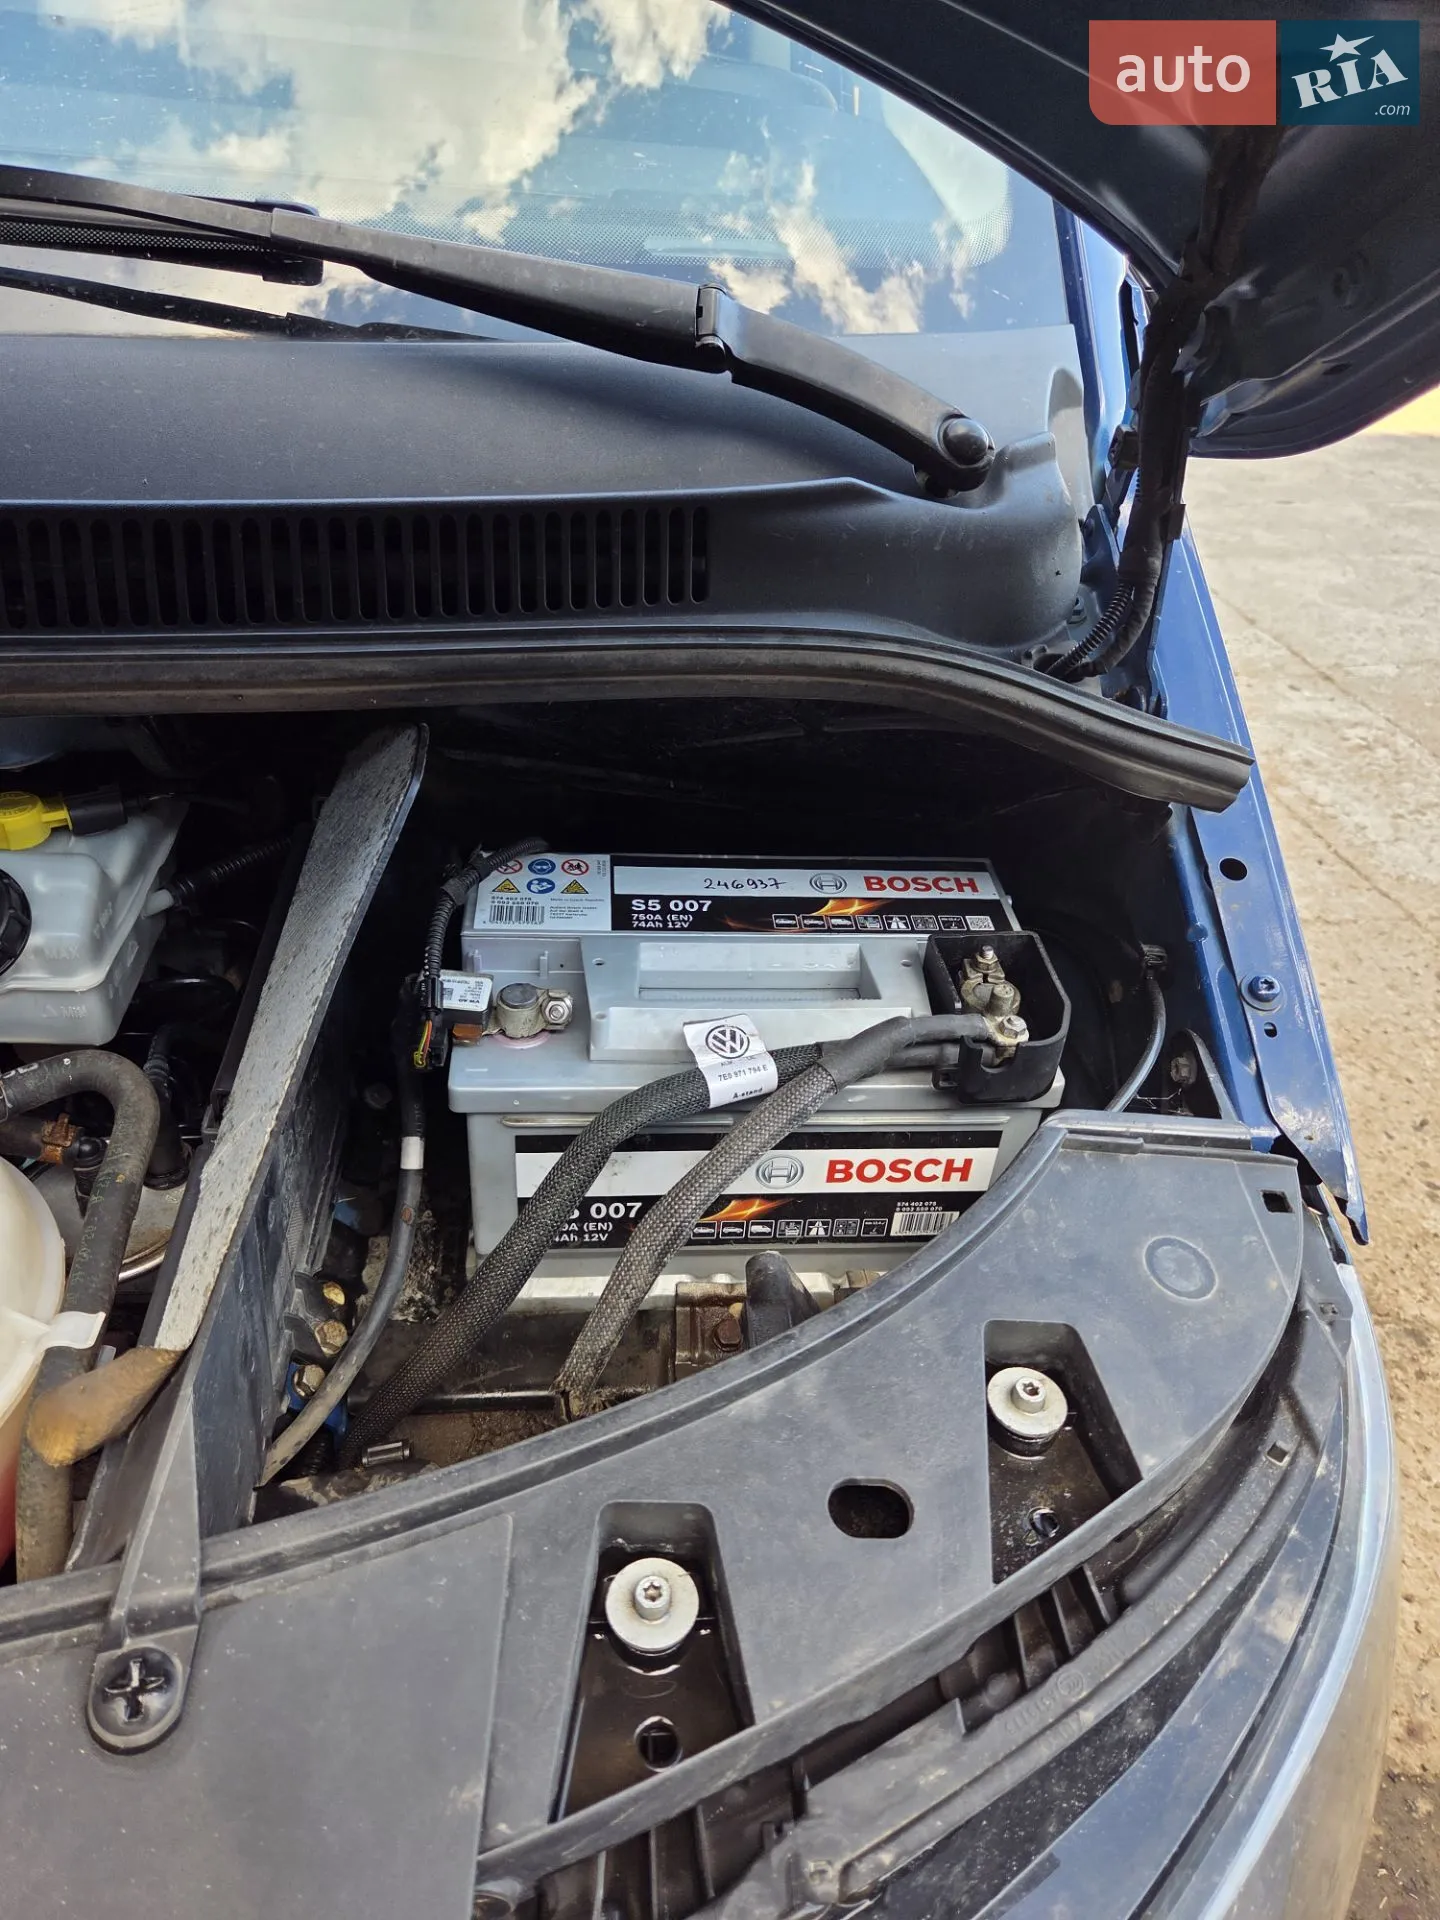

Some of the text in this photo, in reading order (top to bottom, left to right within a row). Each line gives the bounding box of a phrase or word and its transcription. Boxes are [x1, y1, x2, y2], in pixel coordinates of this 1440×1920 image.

[703, 877, 787, 890] 246937
[863, 875, 979, 893] BOSCH
[631, 899, 712, 912] S5 007
[631, 913, 693, 922] 750A (EN)
[631, 920, 690, 929] 74Ah 12V
[825, 1158, 974, 1184] BOSCH
[590, 1202, 643, 1219] 007
[583, 1222, 613, 1232] (EN)
[583, 1233, 609, 1242] 12V
